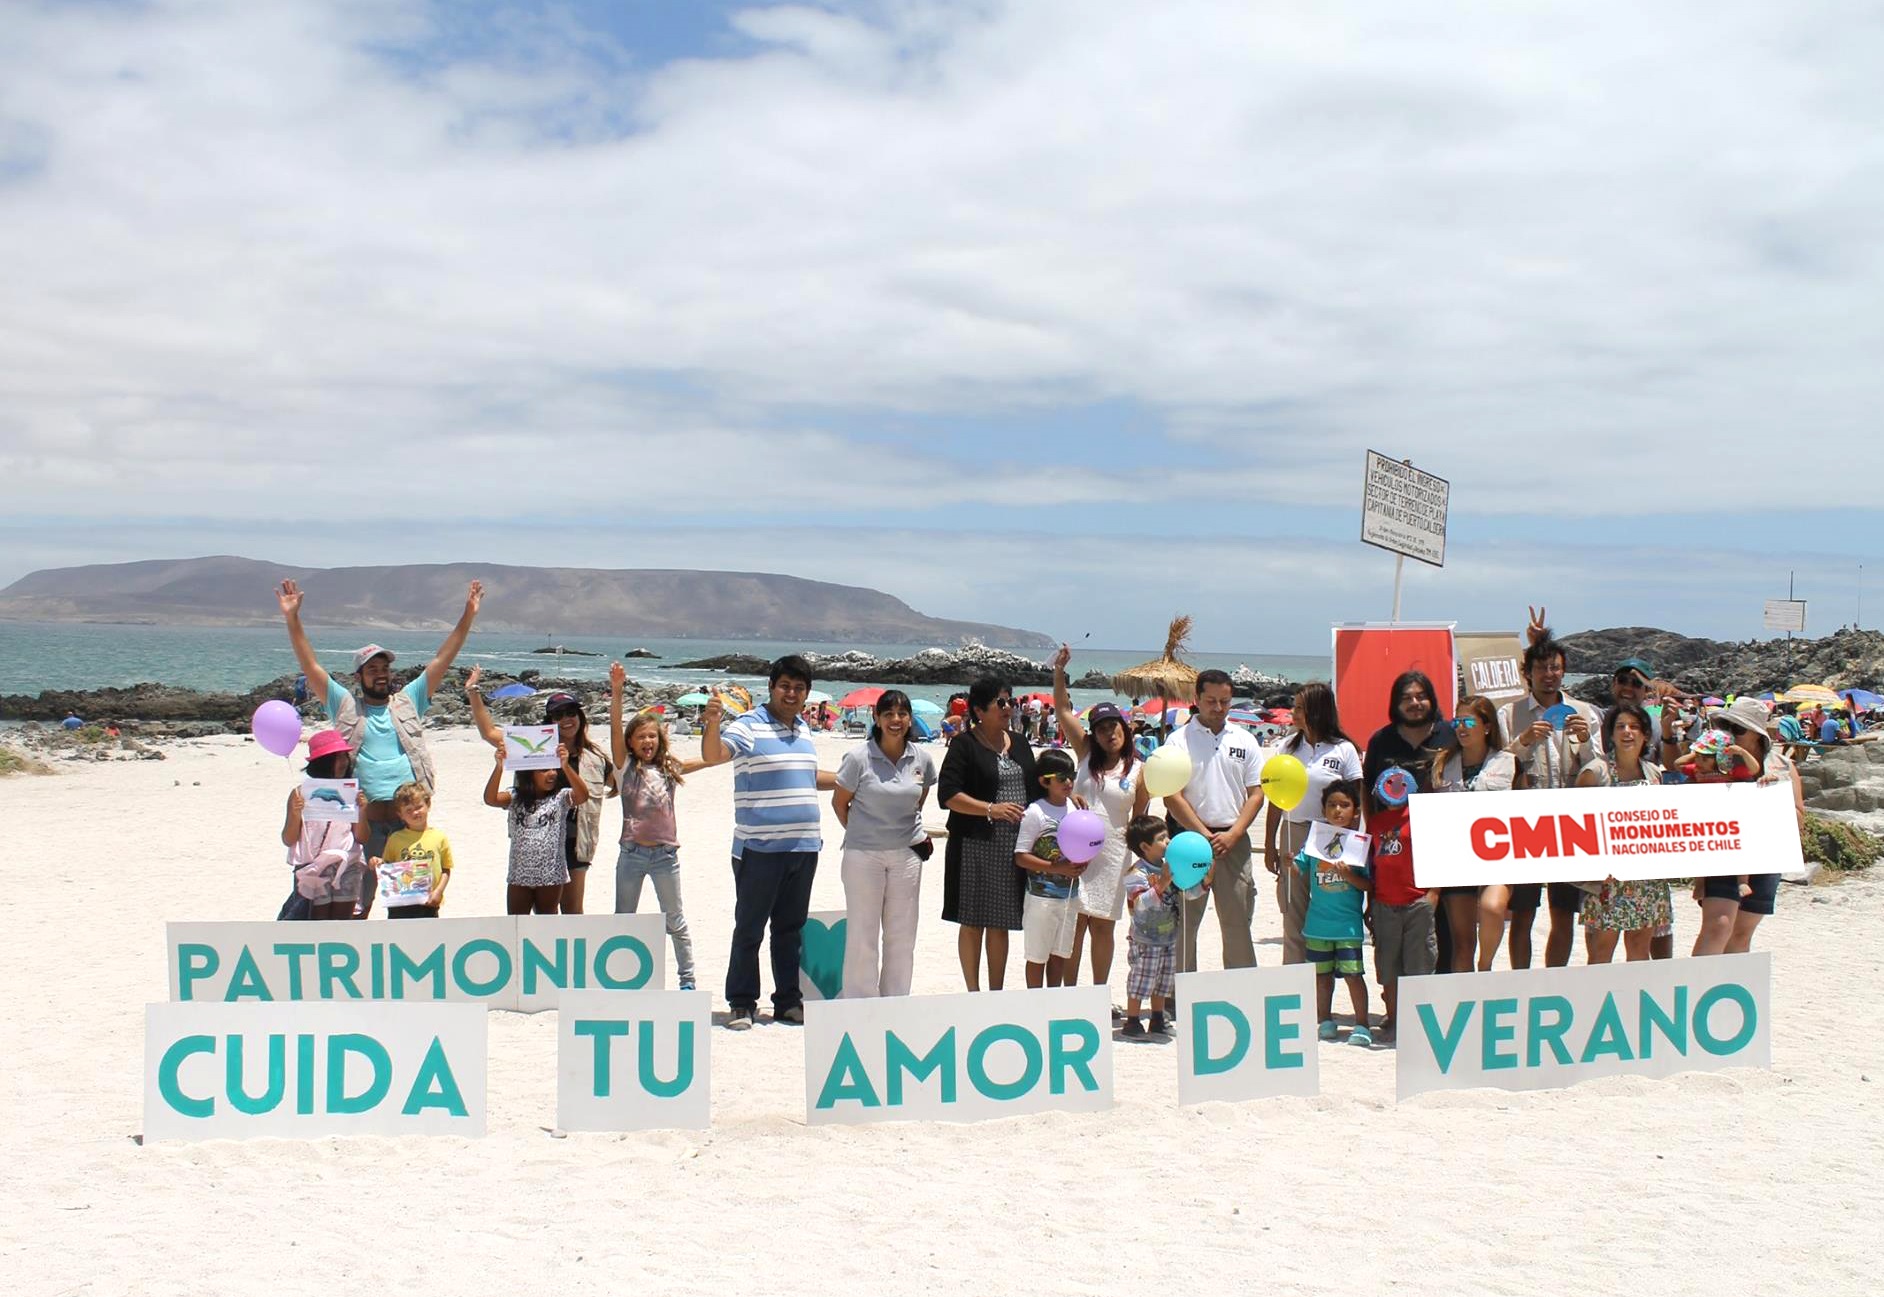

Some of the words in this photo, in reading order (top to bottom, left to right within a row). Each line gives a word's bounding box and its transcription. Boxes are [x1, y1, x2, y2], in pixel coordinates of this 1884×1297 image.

[1408, 469, 1416, 483] EL
[1470, 658, 1521, 690] CALDERA
[1229, 746, 1246, 760] PDI
[1322, 758, 1340, 770] PDI
[1607, 809, 1660, 823] CONSEJO
[1662, 808, 1679, 820] DE
[1609, 820, 1740, 841] MONUMENTOS
[1470, 814, 1600, 861] CMN
[1612, 840, 1687, 856] NACIONALES
[1688, 840, 1705, 852] DE
[1707, 838, 1741, 851] CHILE
[178, 935, 653, 1002] PATRIMONIO
[1193, 996, 1303, 1076] DE
[1418, 984, 1757, 1072] VERANO
[158, 1034, 467, 1118] CUIDA
[575, 1021, 694, 1098] TU
[817, 1019, 1100, 1109] AMOR
